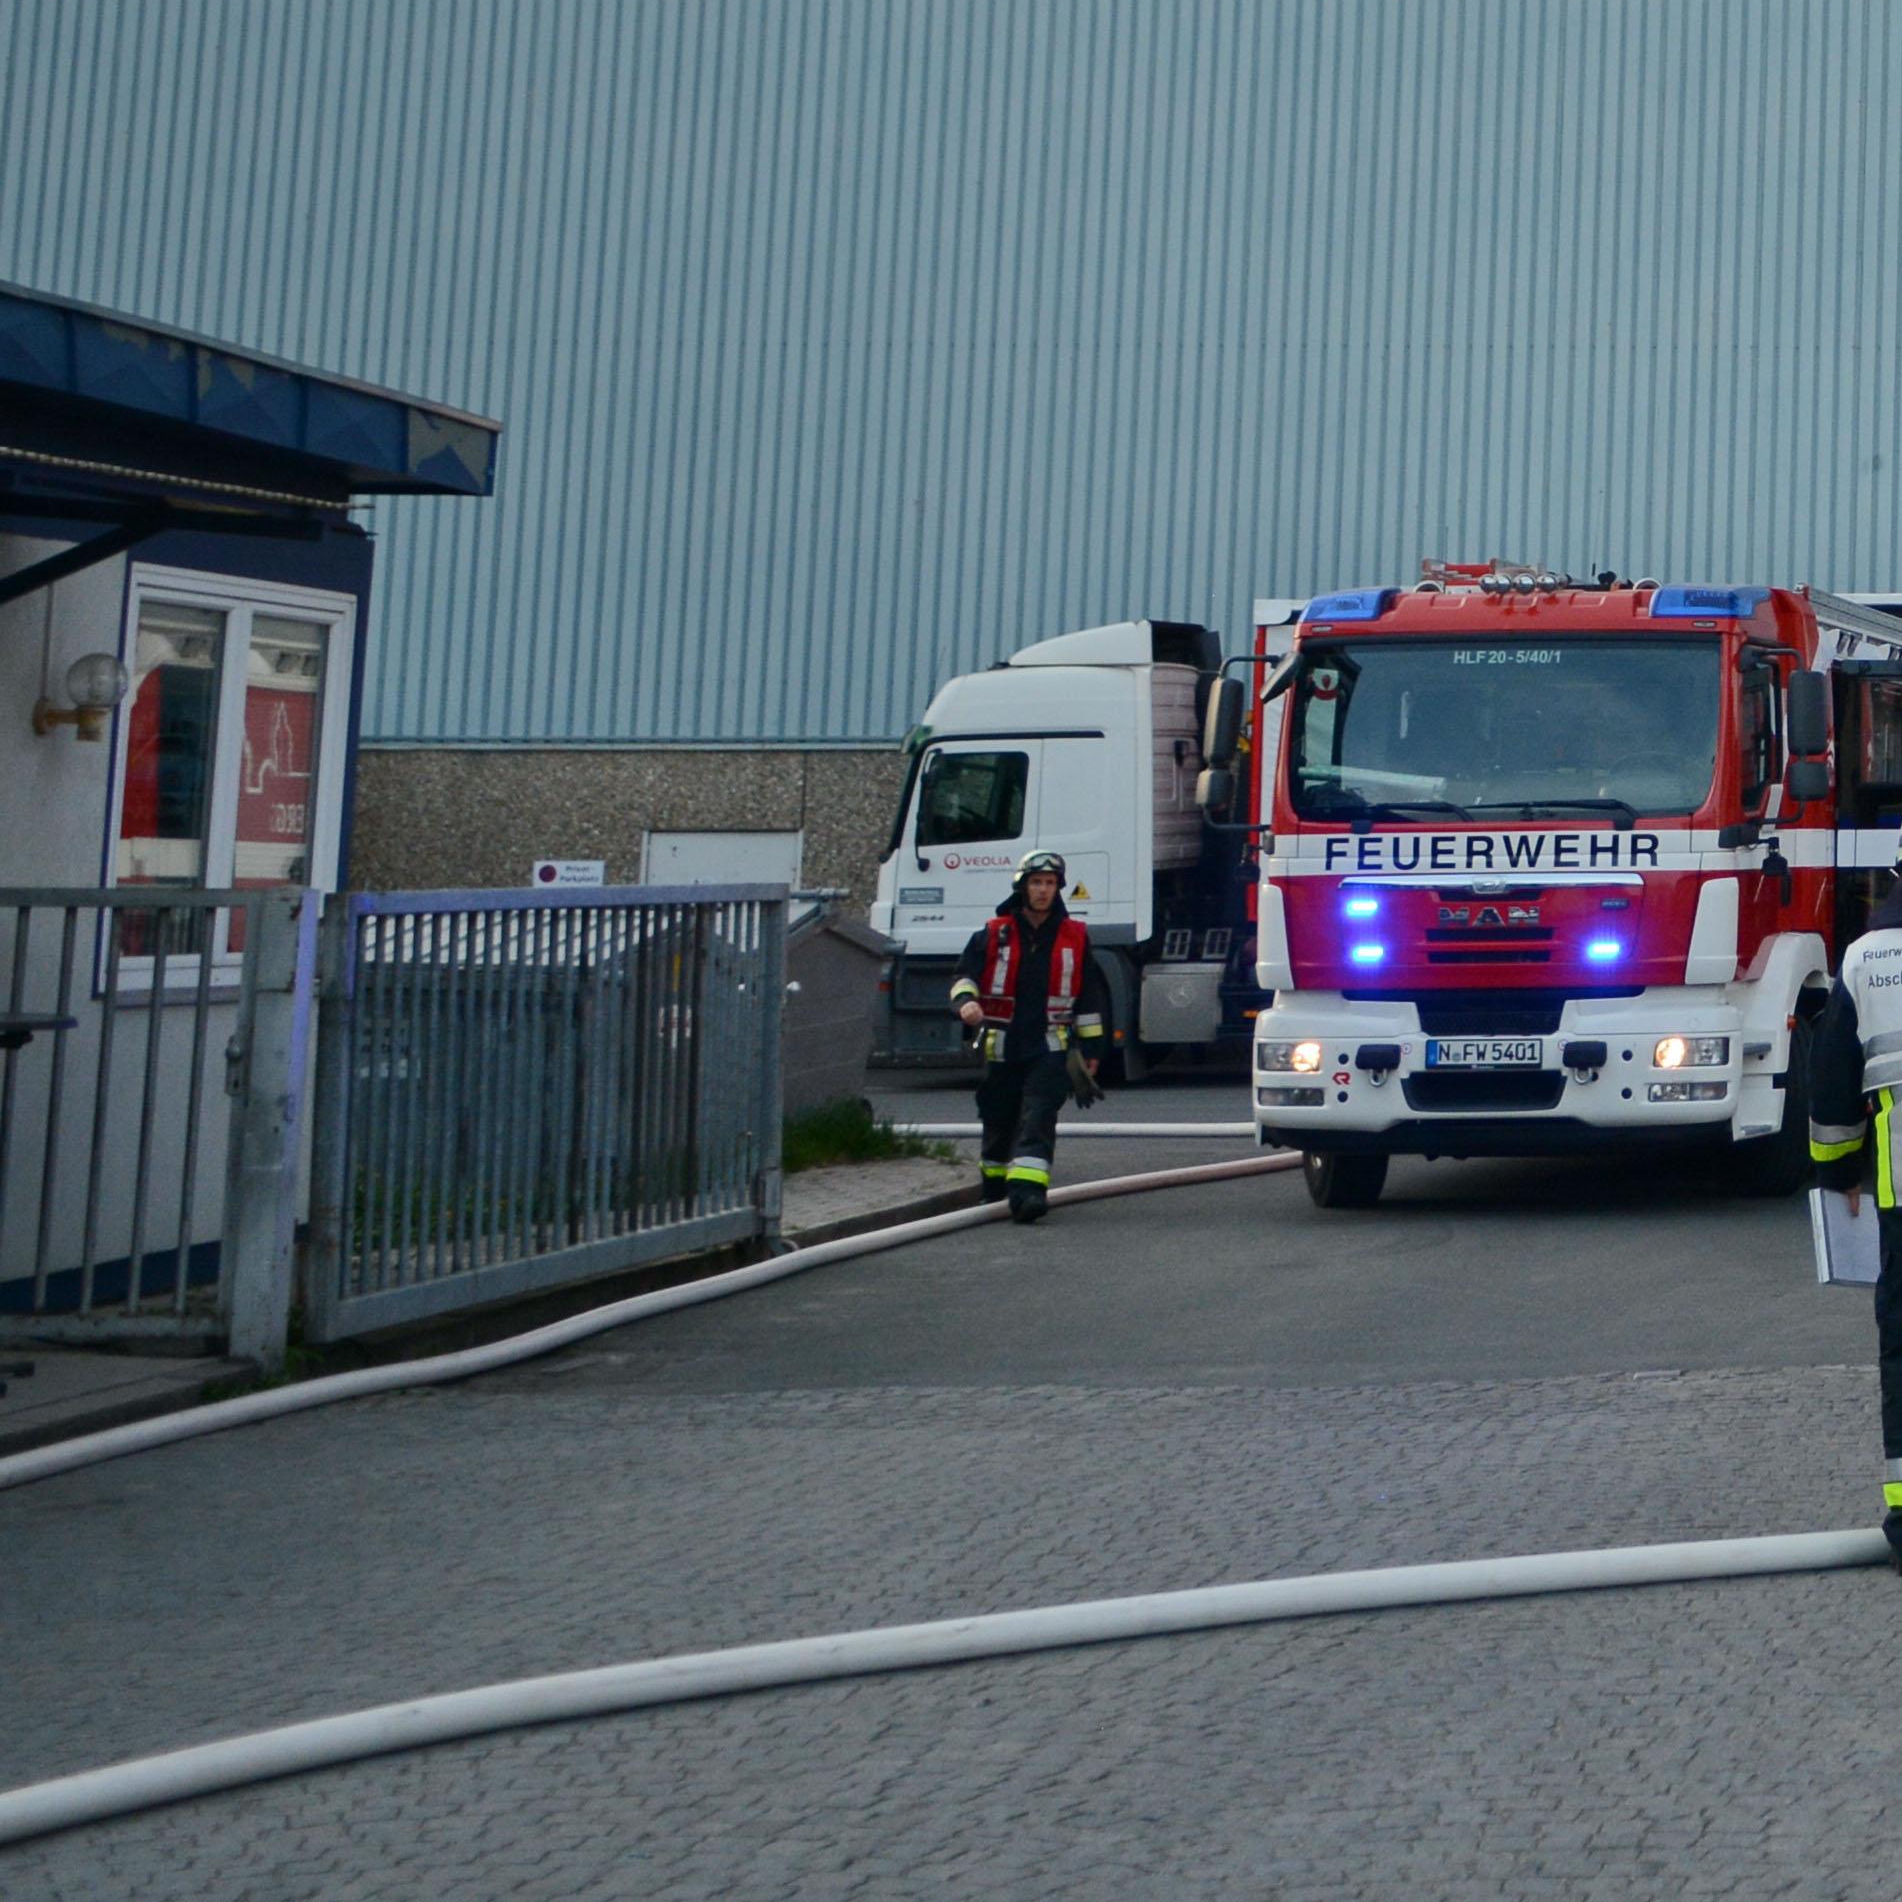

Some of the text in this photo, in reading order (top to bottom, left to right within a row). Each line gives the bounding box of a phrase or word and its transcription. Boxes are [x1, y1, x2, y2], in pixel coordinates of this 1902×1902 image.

[1453, 650, 1486, 665] HLF
[1488, 650, 1507, 664] 20
[1515, 649, 1562, 665] 5/40/1
[962, 856, 1012, 867] VEOLIA
[1324, 834, 1660, 871] FEUERWEHR
[1438, 905, 1541, 928] MAN
[1438, 1042, 1539, 1062] N FW 5401
